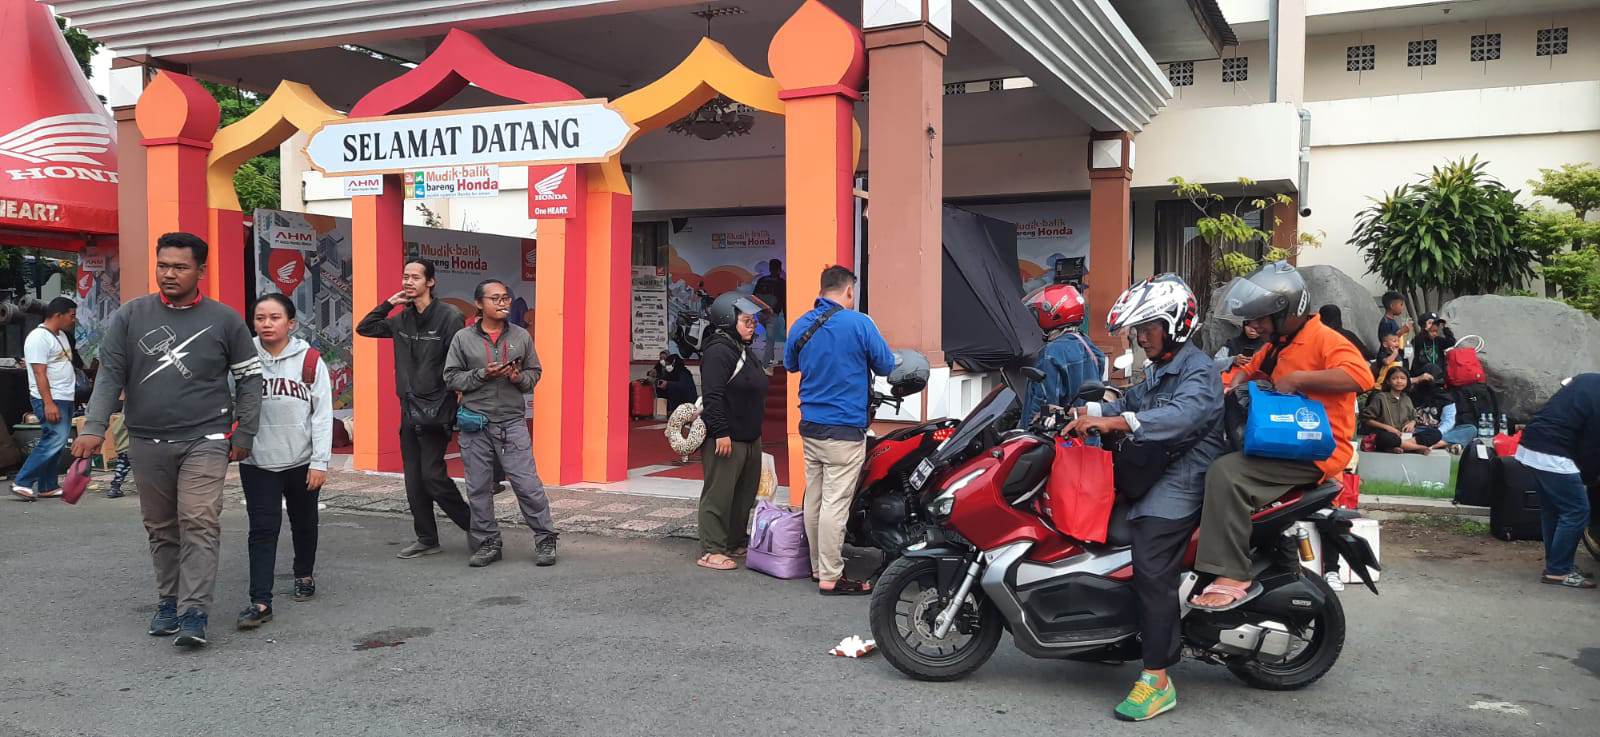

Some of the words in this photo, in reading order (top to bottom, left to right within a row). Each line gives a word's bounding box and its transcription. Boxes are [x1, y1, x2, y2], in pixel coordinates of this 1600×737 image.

[343, 126, 462, 162] SELAMAT
[471, 118, 580, 153] DATANG
[348, 179, 380, 187] AHM
[426, 183, 455, 193] bareng
[457, 177, 499, 191] Honda
[534, 193, 568, 201] HONDA
[534, 207, 547, 215] One
[1038, 226, 1073, 236] Honda
[275, 231, 312, 242] AHM
[451, 255, 488, 271] Honda
